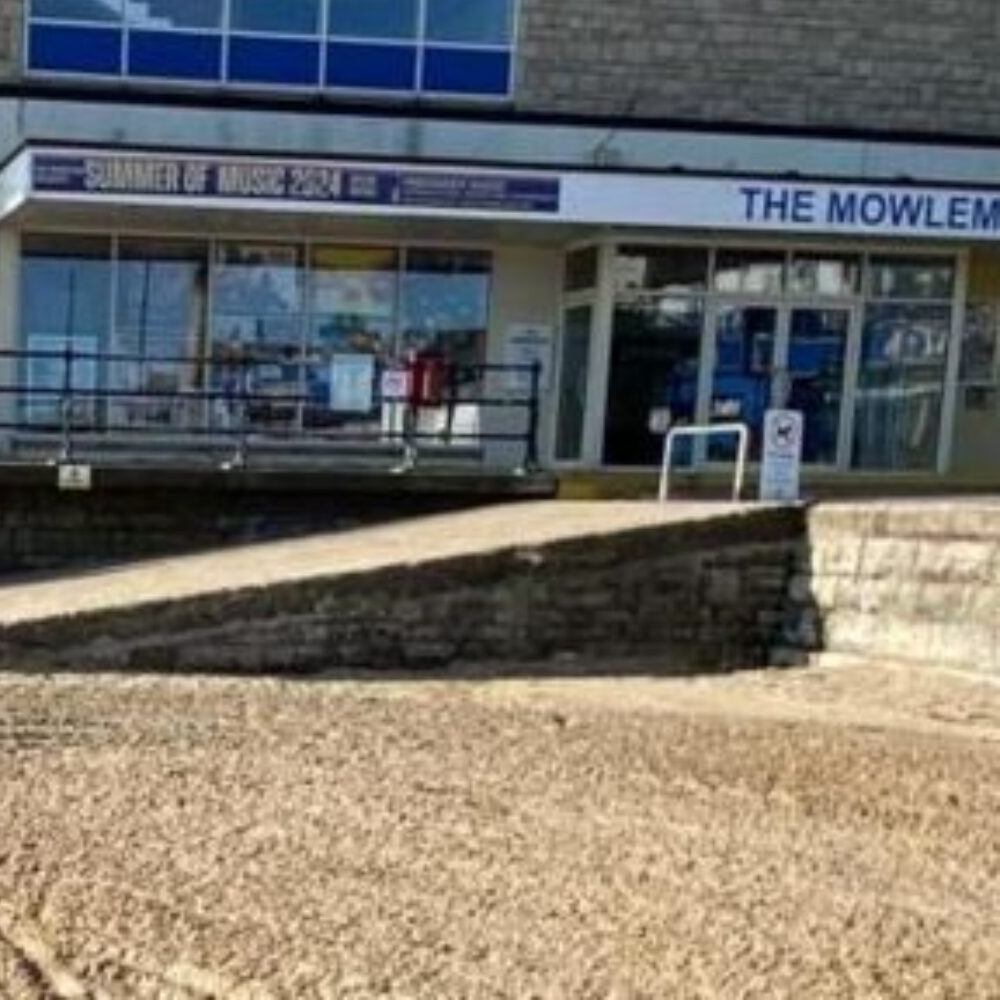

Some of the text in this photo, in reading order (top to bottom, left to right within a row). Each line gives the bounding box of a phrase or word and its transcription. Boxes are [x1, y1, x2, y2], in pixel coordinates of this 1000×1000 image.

[83, 156, 178, 193] SUMMER
[183, 161, 209, 193] OF
[217, 164, 286, 197] MUSIC
[290, 166, 342, 200] 2024
[739, 186, 1000, 232] THE MOWLEM
